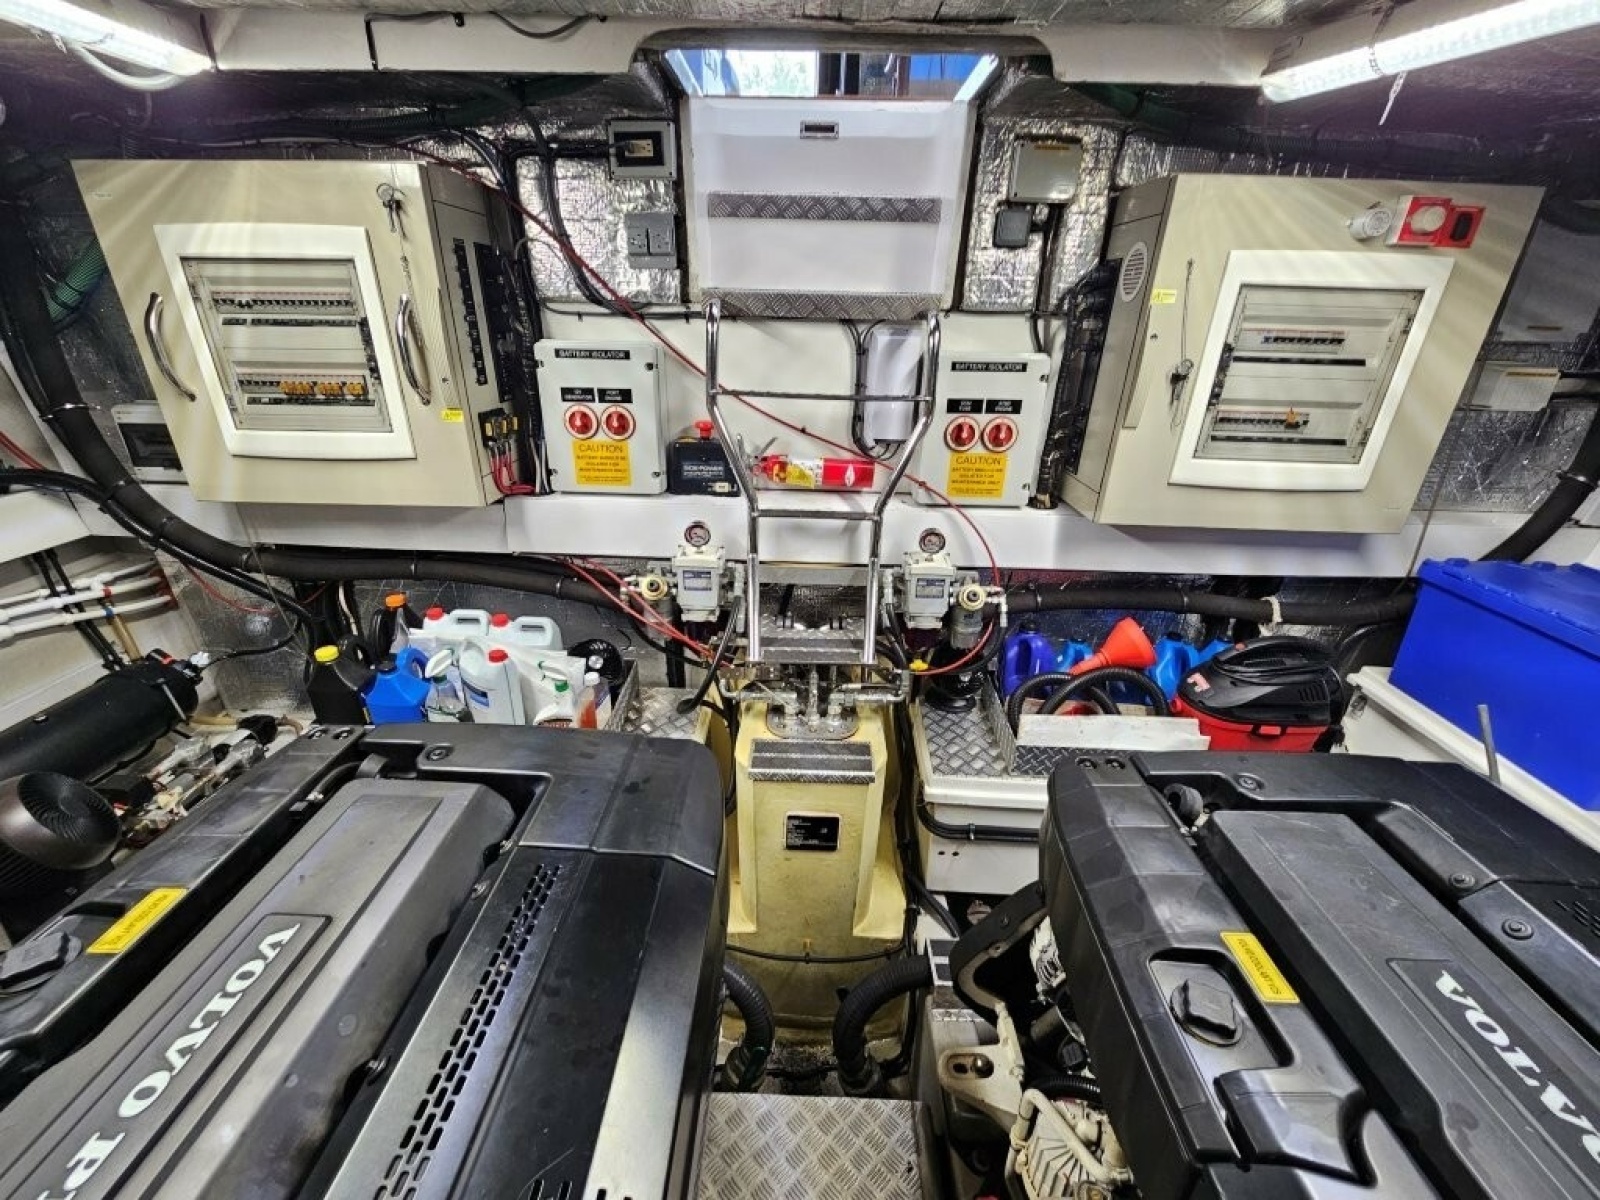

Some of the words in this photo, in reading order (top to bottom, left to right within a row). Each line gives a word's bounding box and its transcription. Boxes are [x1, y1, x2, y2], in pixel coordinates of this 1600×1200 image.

[559, 350, 589, 358] BATTERY
[591, 350, 626, 359] ISOLATOR
[955, 363, 987, 371] BATTERY
[988, 363, 1023, 371] ISOLATOR
[578, 443, 623, 453] CAUTION
[955, 456, 1001, 465] CAUTION
[118, 923, 300, 1118] VOLVO
[64, 1132, 125, 1200] P
